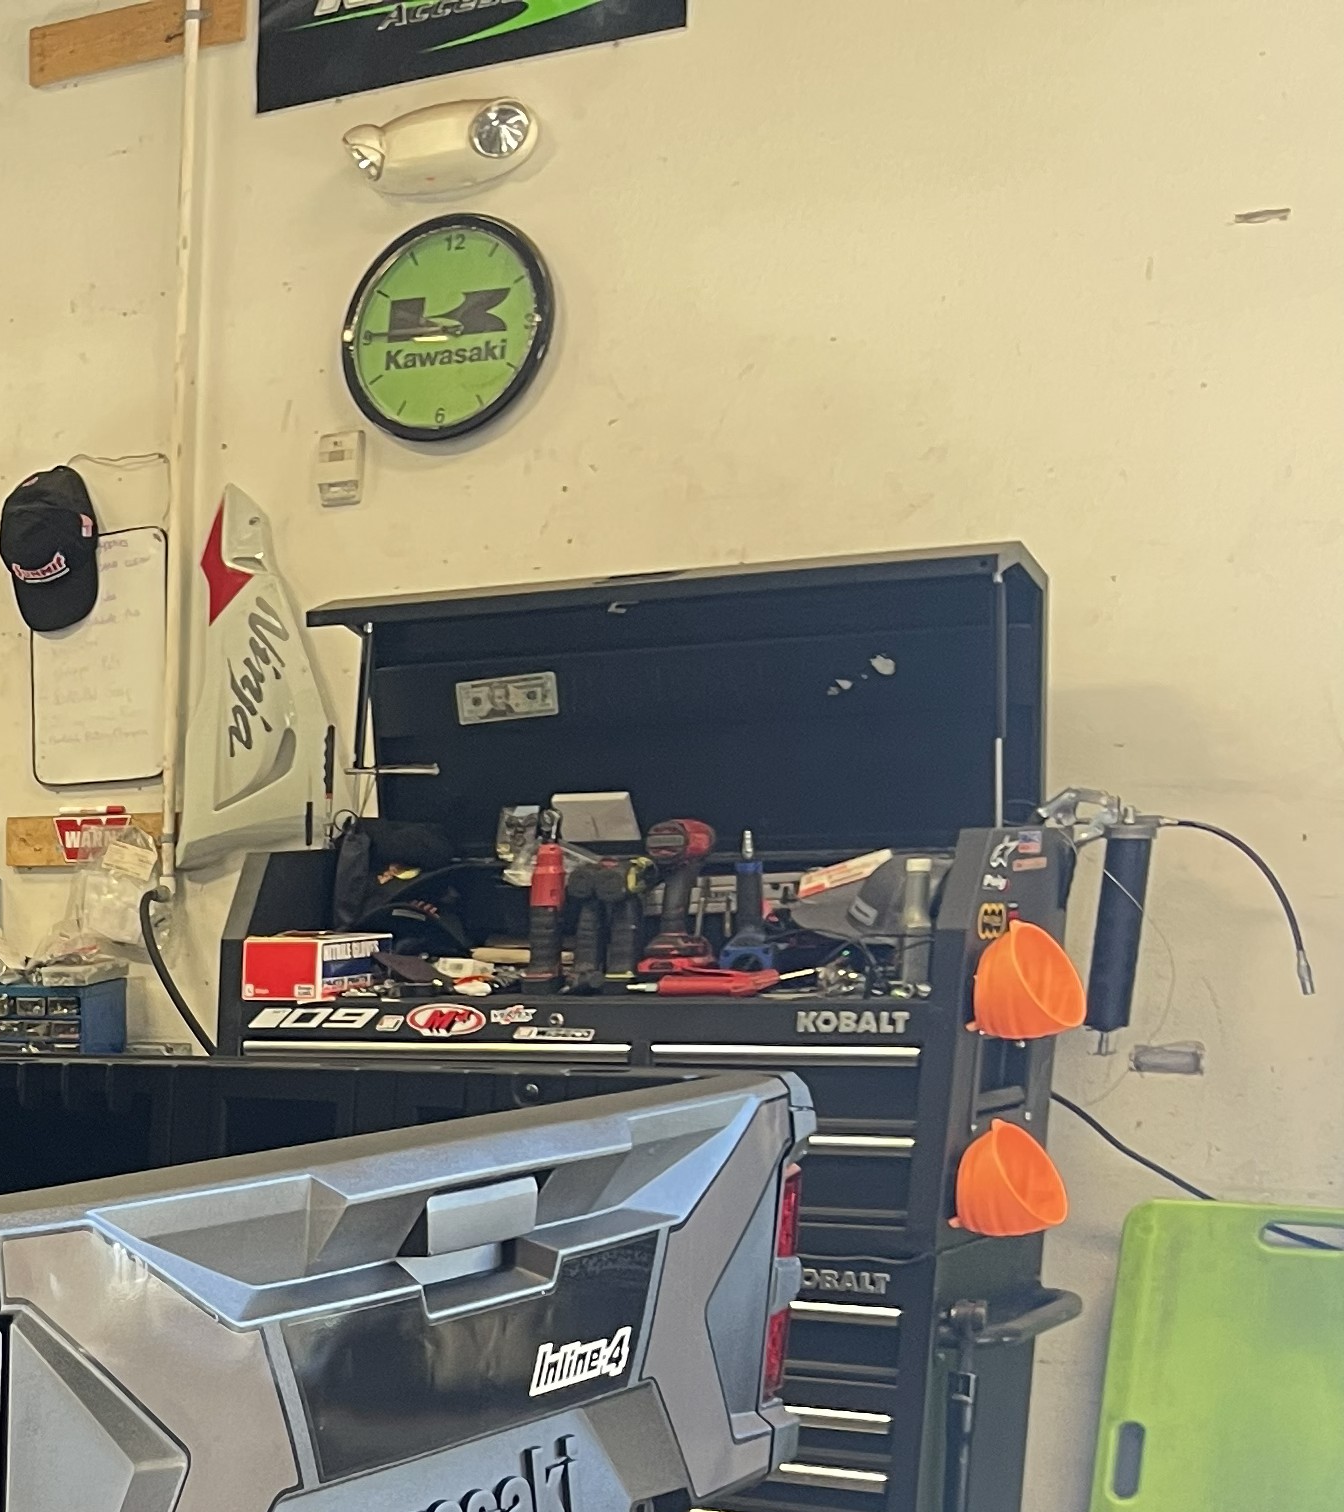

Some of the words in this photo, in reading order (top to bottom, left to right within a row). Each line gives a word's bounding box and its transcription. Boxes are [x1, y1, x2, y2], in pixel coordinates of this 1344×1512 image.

[446, 234, 466, 251] 12
[385, 338, 508, 371] Kawasaki
[434, 407, 446, 424] 6
[228, 596, 290, 758] Ninja
[796, 1010, 910, 1034] KOBALT
[802, 1267, 891, 1295] OBALT
[529, 1325, 633, 1397] Inline-4
